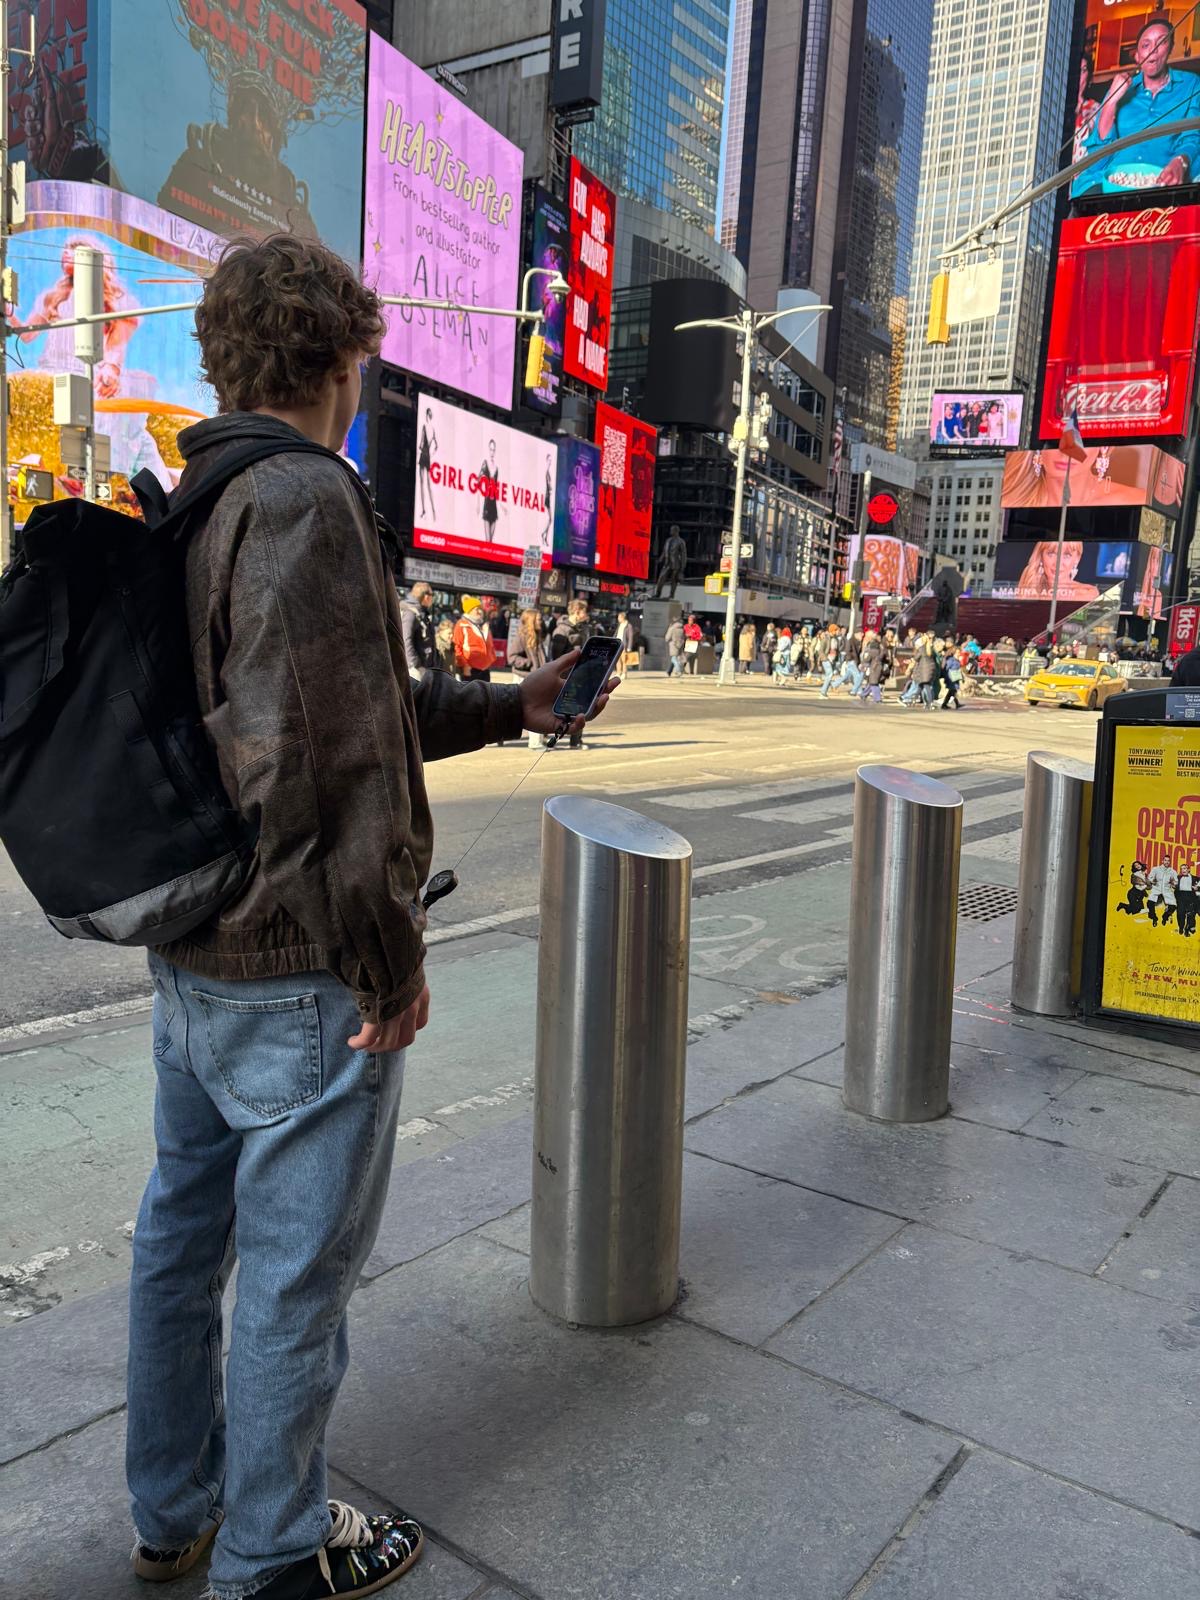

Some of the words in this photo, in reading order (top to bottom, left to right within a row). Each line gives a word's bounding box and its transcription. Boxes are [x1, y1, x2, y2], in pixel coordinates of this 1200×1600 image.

[269, 12, 321, 77] FUN
[275, 56, 315, 106] DIE
[379, 99, 513, 231] HEARTSTOPPER
[394, 172, 418, 204] From
[421, 191, 470, 243] bestselling
[472, 229, 501, 255] author
[573, 176, 588, 219] EVIL
[591, 204, 606, 245] HAS
[1085, 205, 1178, 244] Coca-Cola
[416, 224, 433, 246] and
[435, 230, 481, 270] illustrator
[580, 230, 608, 280] ALWAYS
[413, 254, 480, 308] ALICE
[573, 294, 589, 333] HAD
[578, 333, 585, 365] A
[430, 461, 464, 491] GIRL
[468, 472, 508, 503] GONE
[512, 485, 546, 513] VIRAL
[1177, 607, 1196, 640] tkts
[1127, 757, 1163, 767] WINNER!
[1128, 747, 1144, 755] TONY
[1144, 973, 1173, 983] NEW
